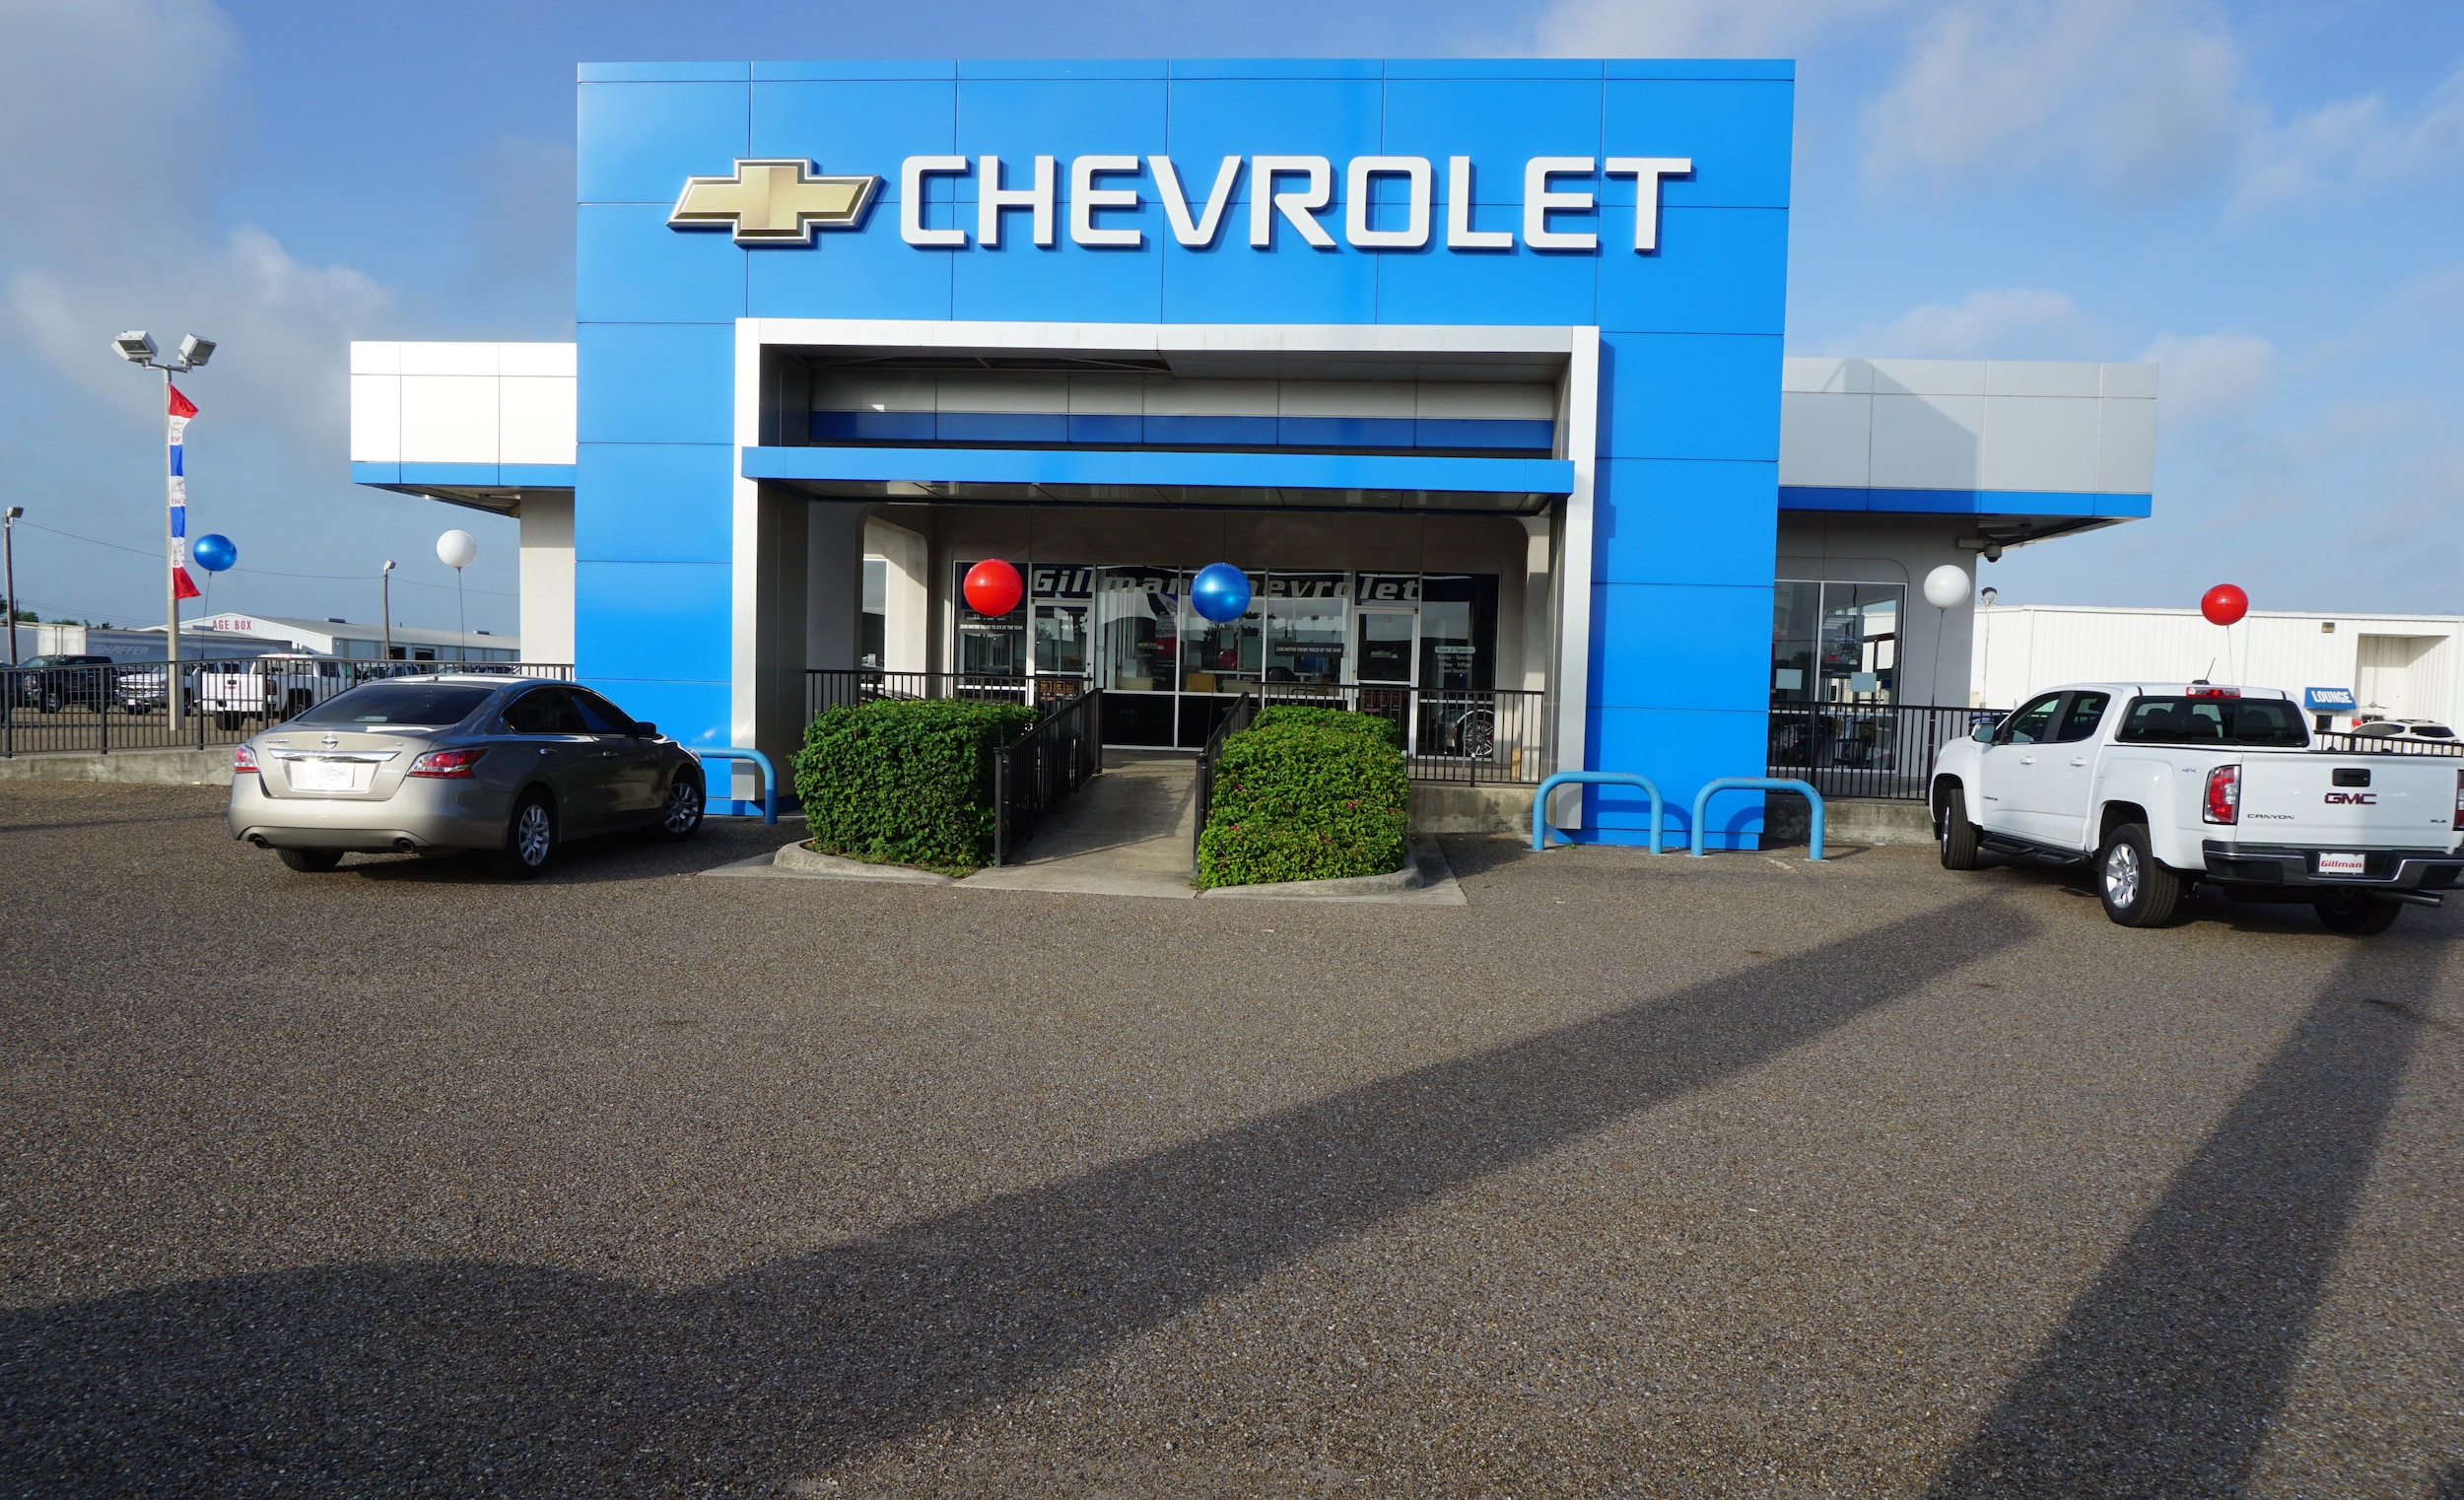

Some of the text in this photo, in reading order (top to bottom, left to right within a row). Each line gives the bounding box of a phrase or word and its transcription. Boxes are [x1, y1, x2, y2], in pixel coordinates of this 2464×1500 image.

[901, 155, 1691, 252] CHEVROLET
[1034, 569, 1419, 600] Gillman evrolet
[212, 620, 251, 631] AGE BOX
[2311, 690, 2353, 703] LOUNGE
[2324, 792, 2376, 804] GMC
[2320, 859, 2362, 869] Gillman
